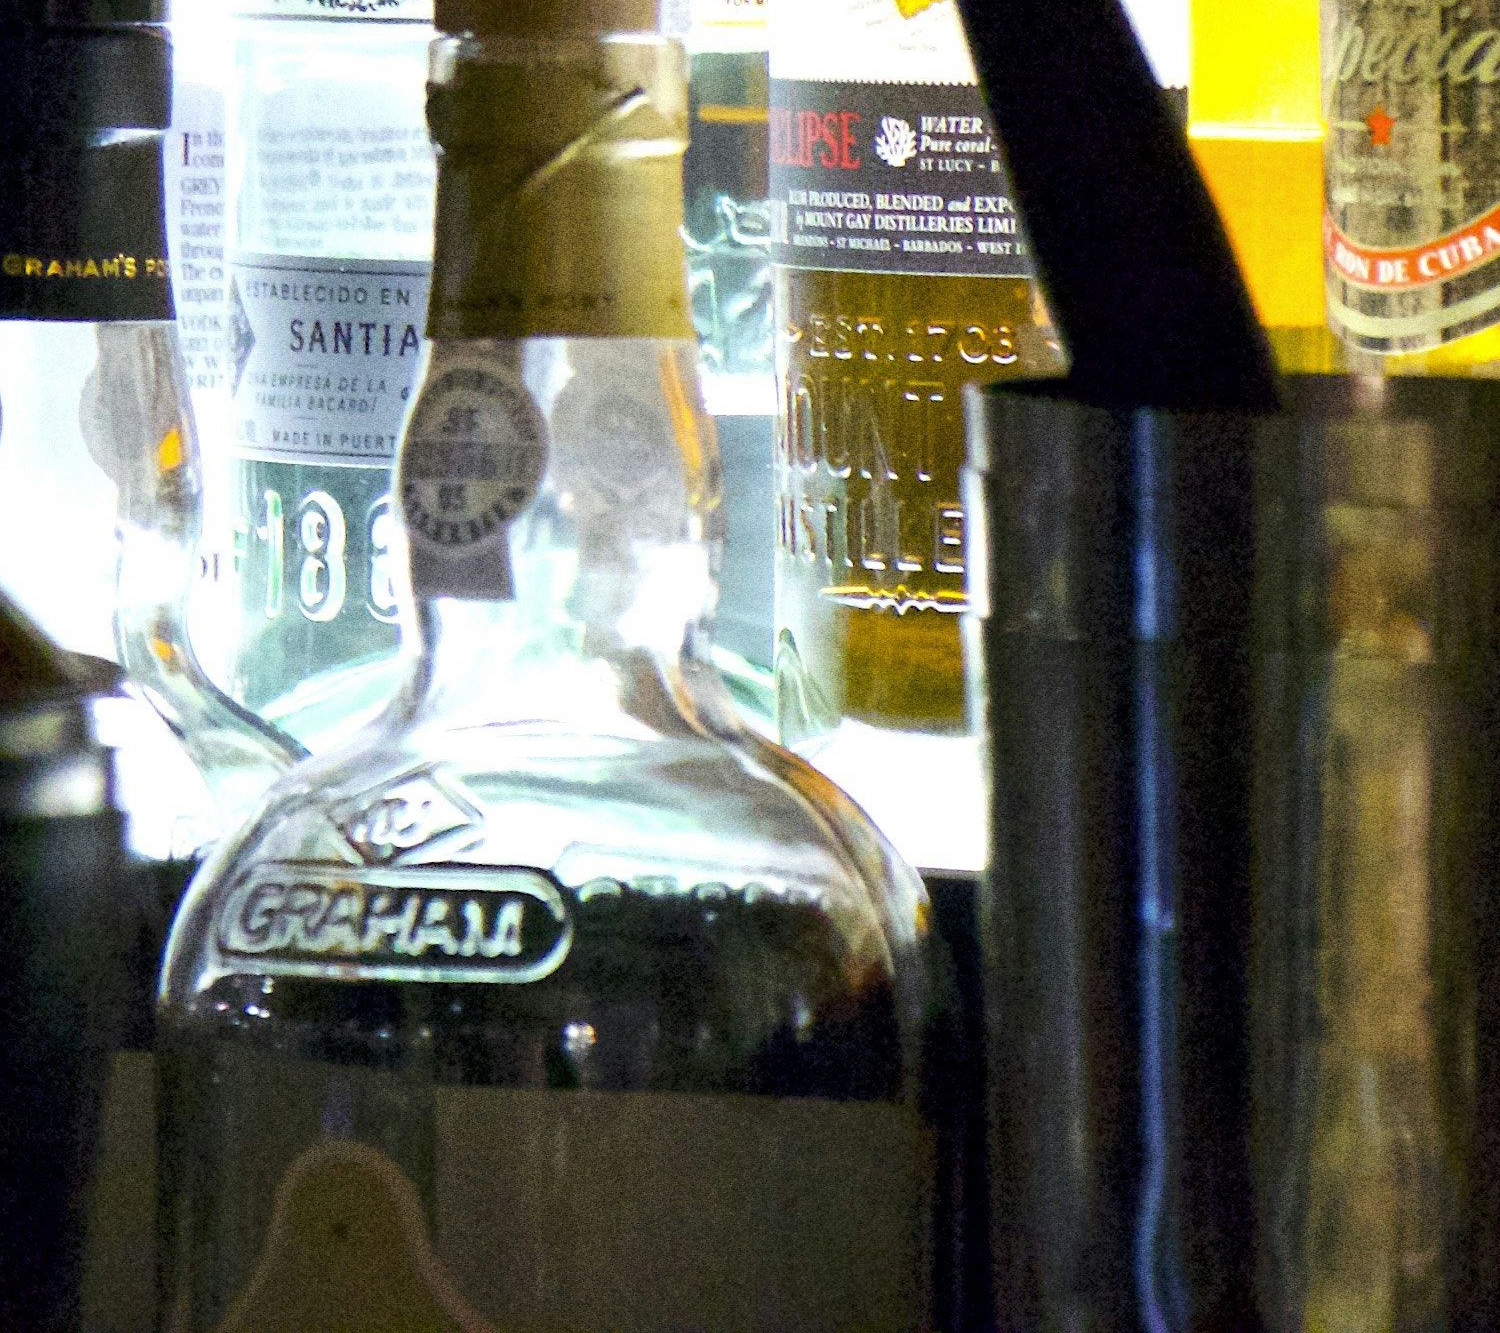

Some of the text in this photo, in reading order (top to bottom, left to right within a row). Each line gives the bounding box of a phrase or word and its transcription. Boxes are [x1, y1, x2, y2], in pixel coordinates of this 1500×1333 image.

[920, 116, 984, 134] WATER
[919, 135, 951, 153] Pure
[919, 158, 973, 172] ST LUCY
[808, 191, 874, 210] PRODUCED,
[875, 193, 944, 212] BLENDED
[947, 197, 971, 212] and
[804, 211, 1017, 234] MOUNT GAY DISTILLERIES LIMI
[902, 237, 964, 254] BARBADOS
[976, 241, 1013, 256] WEST
[2, 252, 137, 278] GRAHAM'S
[1378, 258, 1409, 283] DE
[245, 281, 411, 307] ESTABLECIDO EN
[289, 318, 420, 358] SANTIA
[337, 376, 361, 392] DE
[367, 377, 388, 394] LA
[272, 429, 310, 447] MADE
[339, 433, 398, 451] PUERT
[220, 881, 524, 960] GRAHAM
